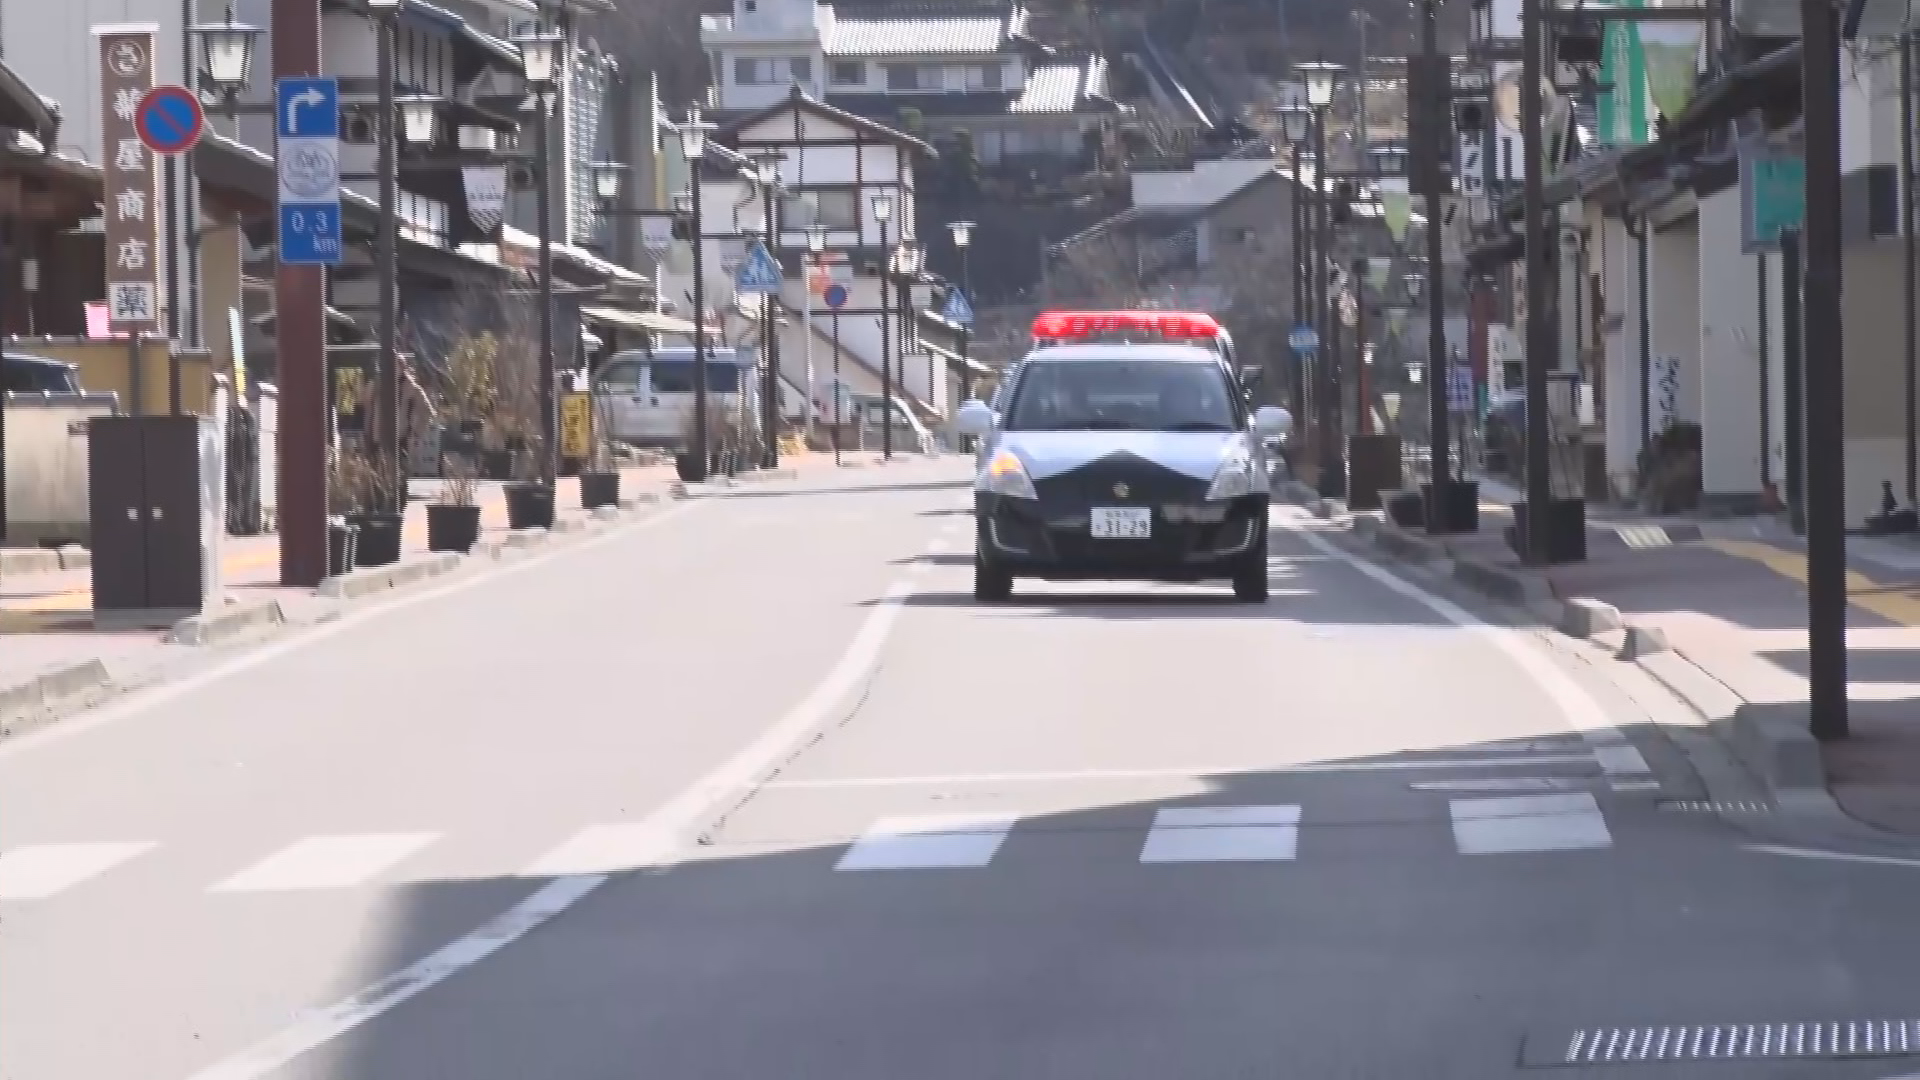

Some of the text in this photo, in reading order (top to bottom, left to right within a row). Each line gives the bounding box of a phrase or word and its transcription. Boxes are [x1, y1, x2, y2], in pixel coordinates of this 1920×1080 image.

[291, 210, 329, 233] 0.3
[313, 234, 338, 253] km
[1104, 520, 1148, 536] 31-29
